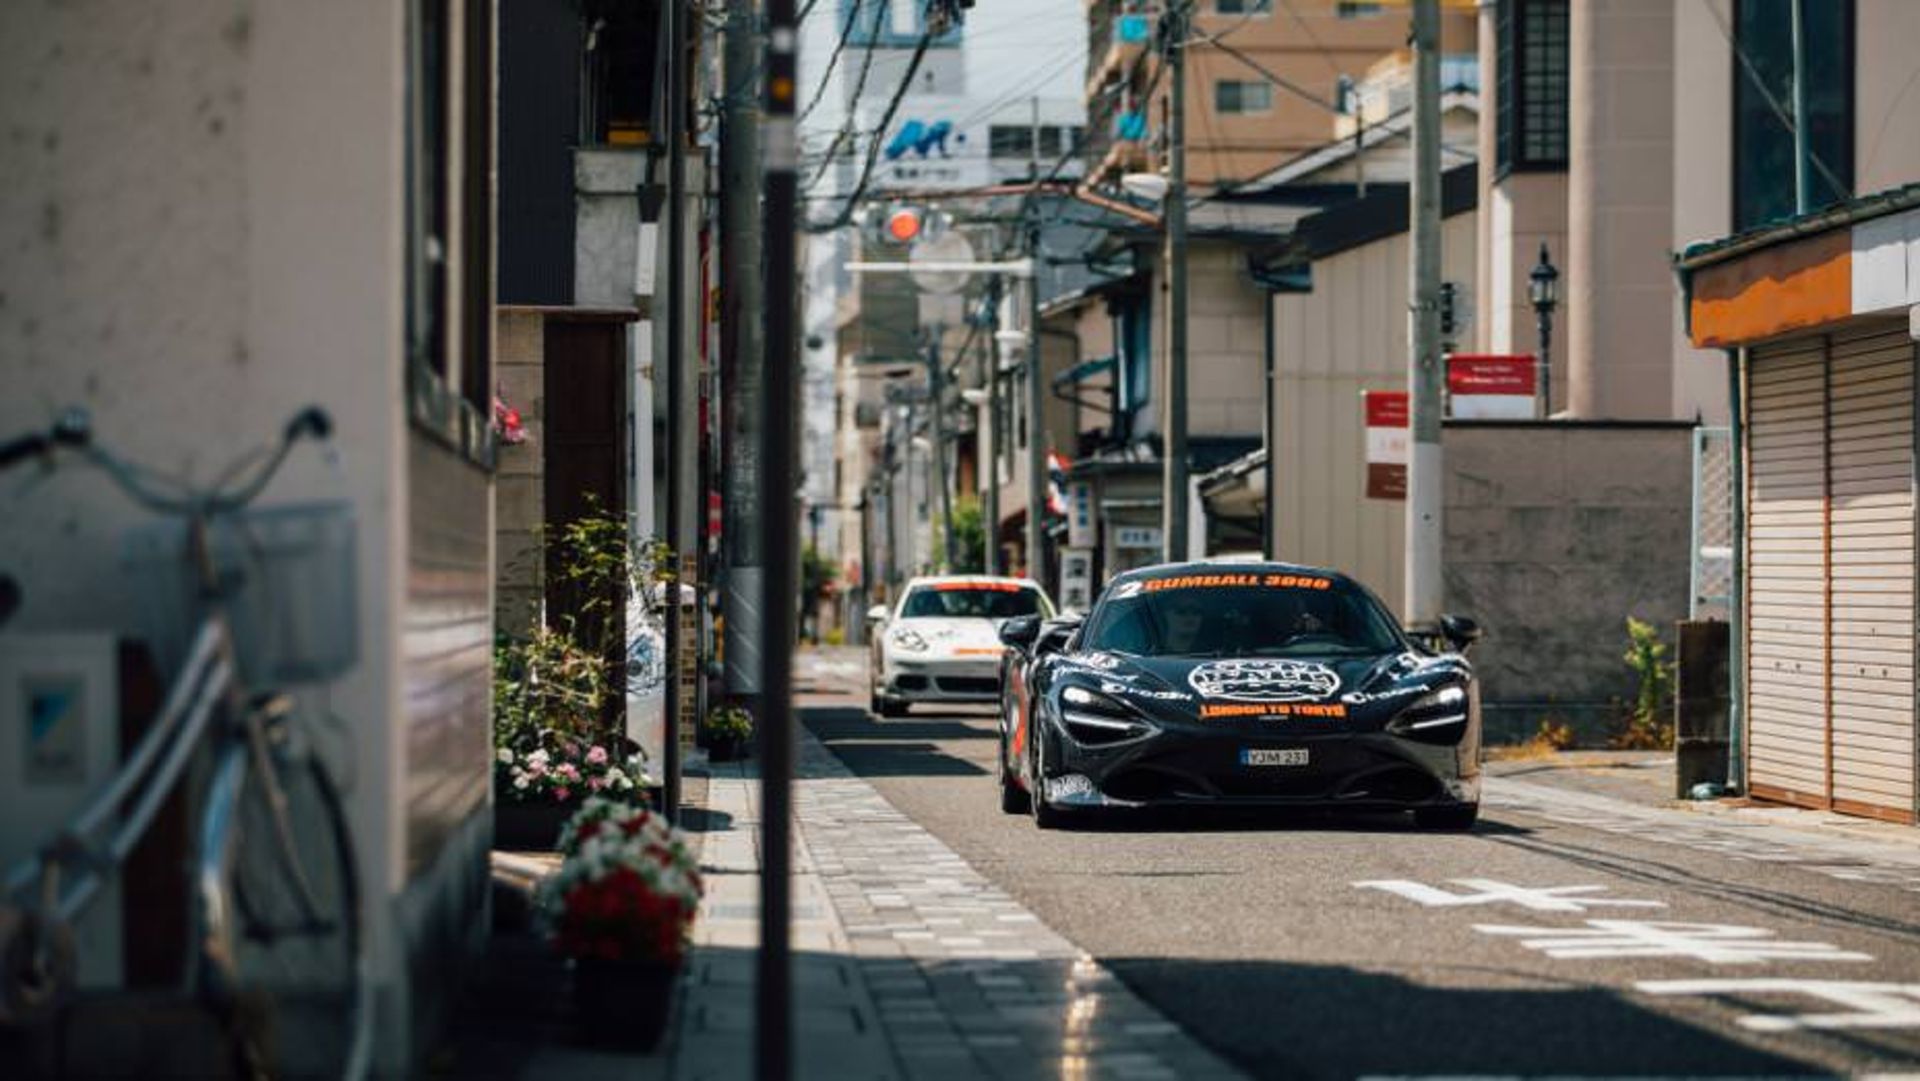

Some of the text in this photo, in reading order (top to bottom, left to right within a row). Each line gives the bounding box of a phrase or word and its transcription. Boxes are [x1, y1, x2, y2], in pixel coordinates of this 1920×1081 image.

[1144, 574, 1331, 591] GUMBALL 3000
[1201, 703, 1347, 718] LONDON TO TOKYO
[1251, 750, 1281, 764] YJM
